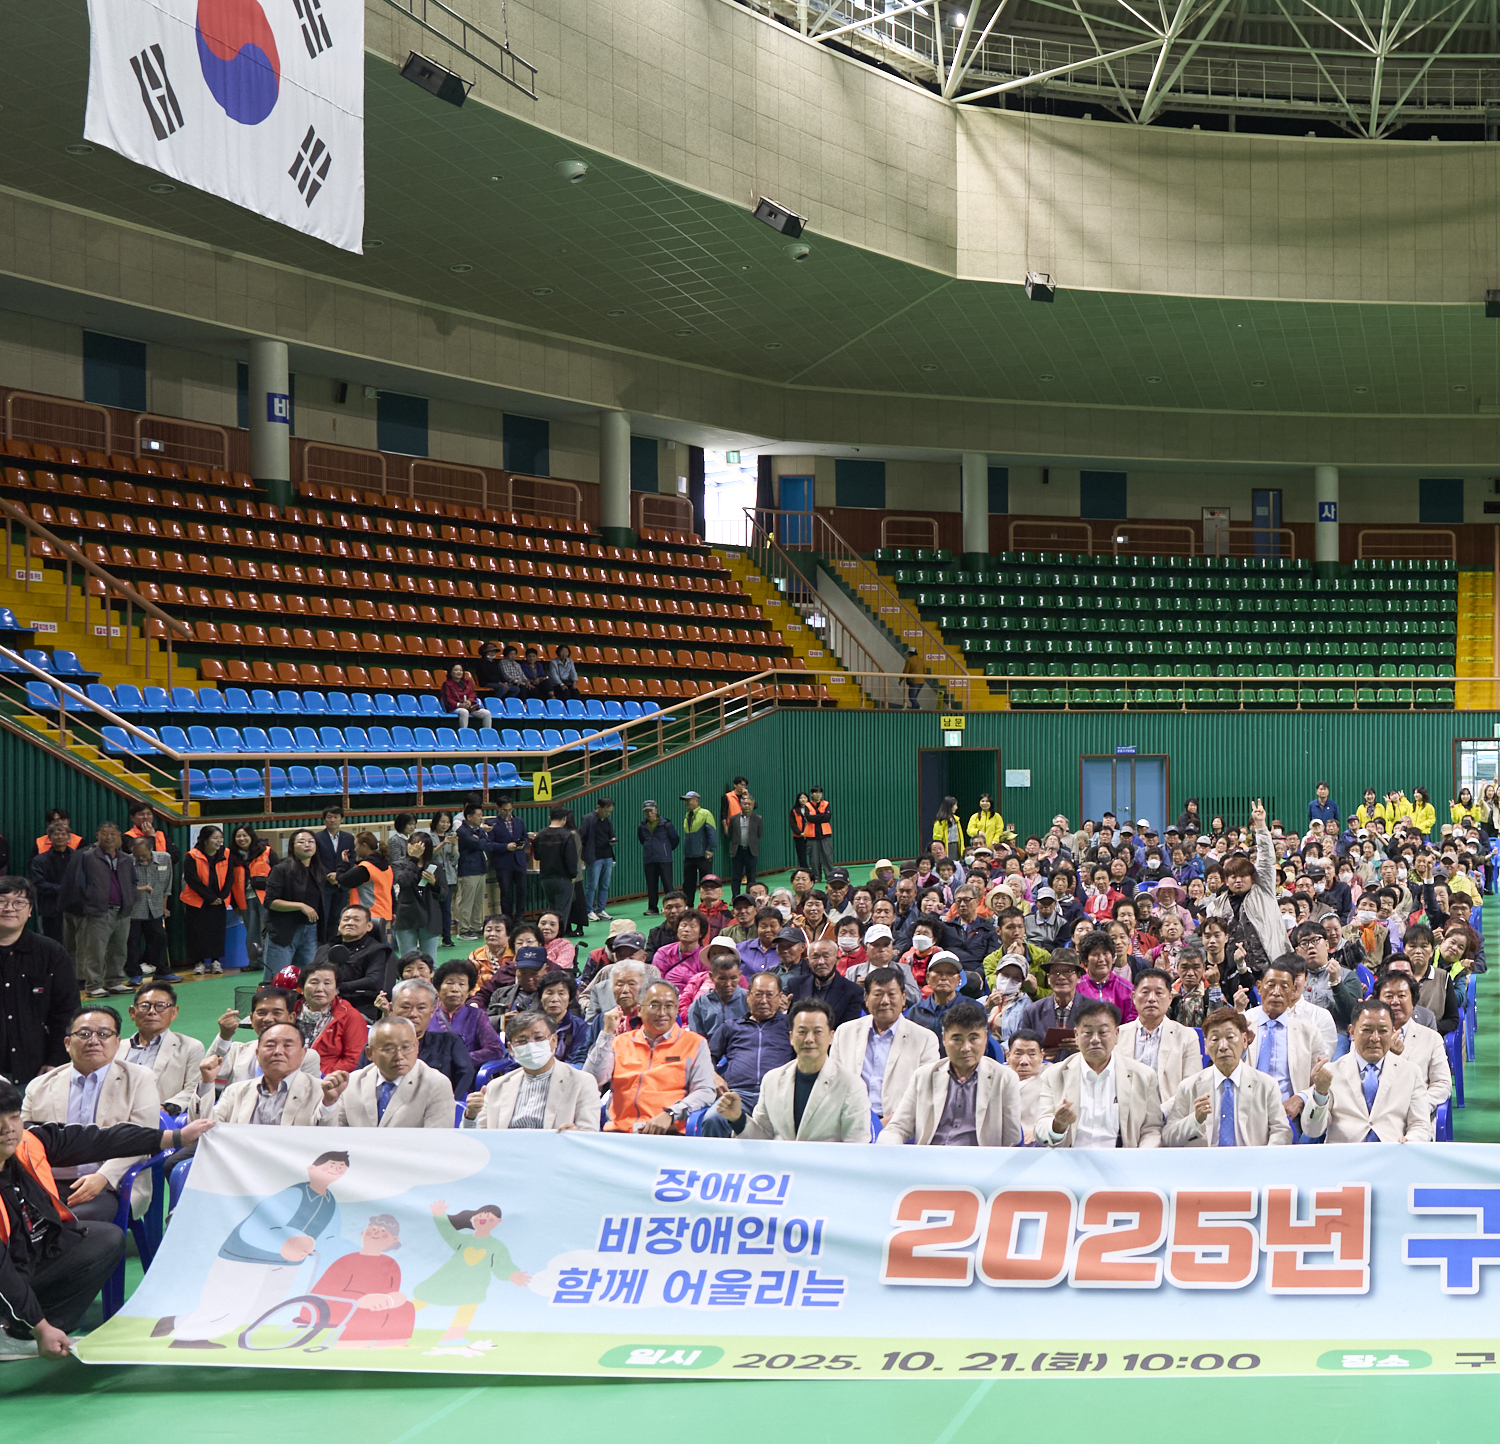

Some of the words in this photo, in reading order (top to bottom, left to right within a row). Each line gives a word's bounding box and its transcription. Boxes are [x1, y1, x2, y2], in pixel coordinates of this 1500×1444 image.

[1322, 504, 1336, 519] 사
[537, 775, 549, 795] A
[654, 1168, 790, 1205] 장애인
[598, 1216, 825, 1255] 비장애인이
[884, 1183, 1367, 1291] 2025년
[552, 1267, 649, 1305] 함께
[662, 1268, 845, 1307] 어울리는
[625, 1348, 703, 1366] 일시
[732, 1353, 862, 1371] 2025.
[881, 1351, 944, 1372] 10.
[958, 1351, 1108, 1372] 21.(화)
[1123, 1353, 1261, 1372] 10:00
[1341, 1354, 1411, 1369] 장소
